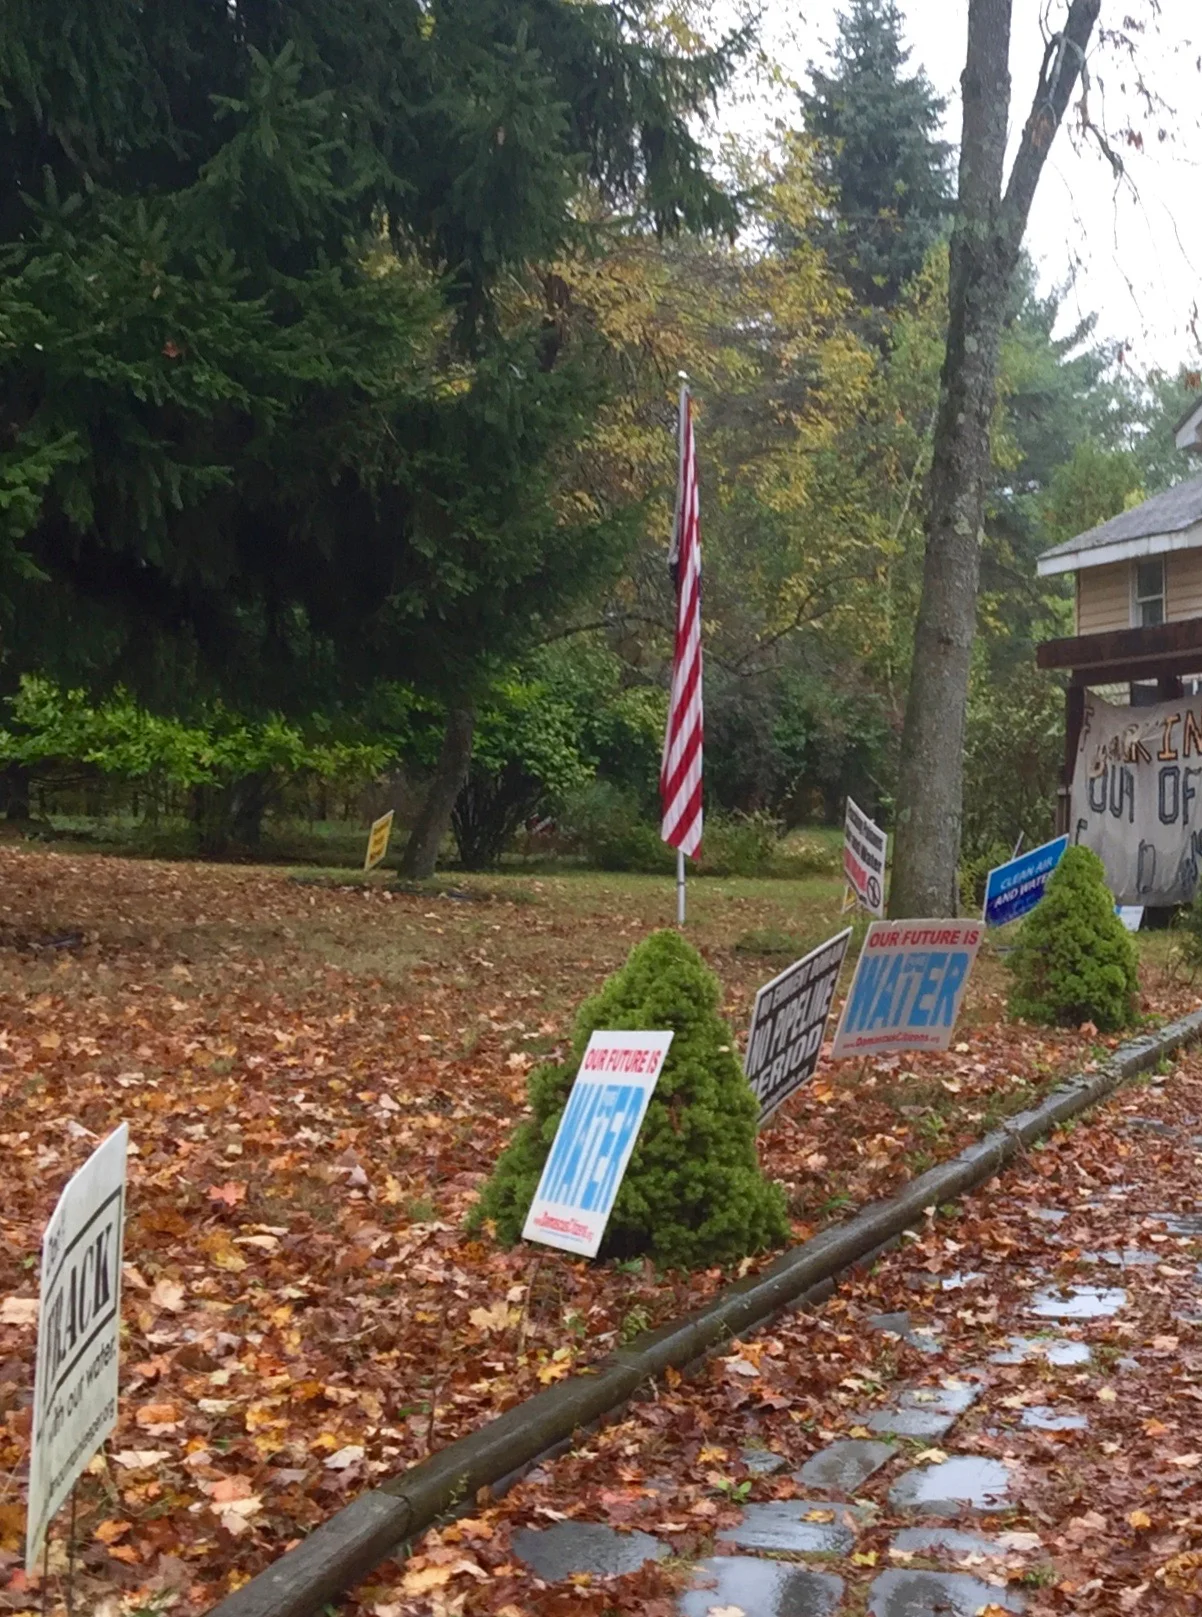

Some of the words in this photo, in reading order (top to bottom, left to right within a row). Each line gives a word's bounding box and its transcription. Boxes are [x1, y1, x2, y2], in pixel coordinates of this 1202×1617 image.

[1158, 765, 1202, 826] OF
[994, 887, 1019, 909] AND
[1000, 864, 1035, 890] CLEAN
[1035, 855, 1054, 874] AIR
[869, 931, 902, 949] OUR
[901, 929, 961, 946] FUTURE
[962, 929, 980, 946] IS
[843, 951, 970, 1035] WATER
[748, 1018, 773, 1077] NO
[769, 968, 838, 1060] PIPELINE
[584, 1047, 607, 1072] OUR
[606, 1048, 647, 1074] FUTURE
[646, 1049, 663, 1075] IS
[540, 1082, 645, 1213] WATER
[46, 1221, 115, 1385] FRACK
[66, 1374, 84, 1417] our
